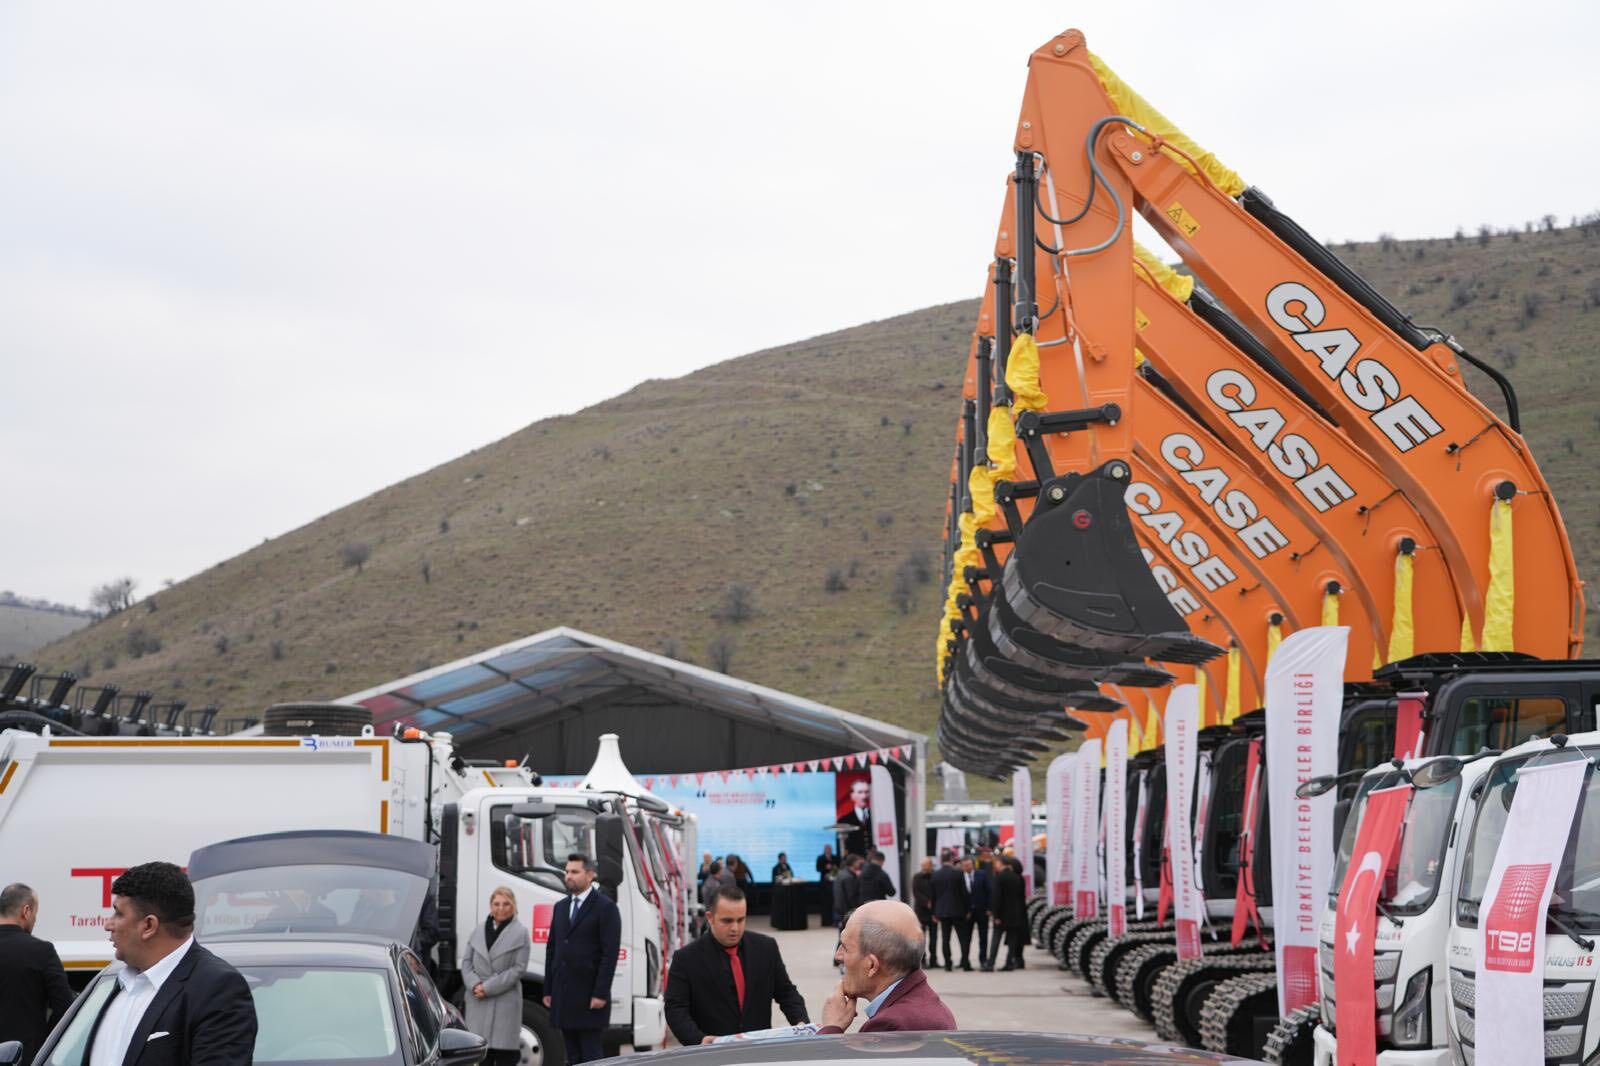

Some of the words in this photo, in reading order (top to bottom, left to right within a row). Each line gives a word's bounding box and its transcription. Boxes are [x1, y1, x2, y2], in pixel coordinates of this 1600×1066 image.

[1265, 282, 1445, 454] CASE
[1205, 368, 1357, 513] CASE
[1123, 482, 1238, 592] CASE
[1160, 433, 1291, 560] CASE
[1140, 547, 1203, 618] SE
[1293, 673, 1314, 735] BİRLİĞİ
[1294, 745, 1312, 853] BELEDİELER
[1296, 863, 1313, 932] TÜRKİYE
[1488, 929, 1532, 953] TBB
